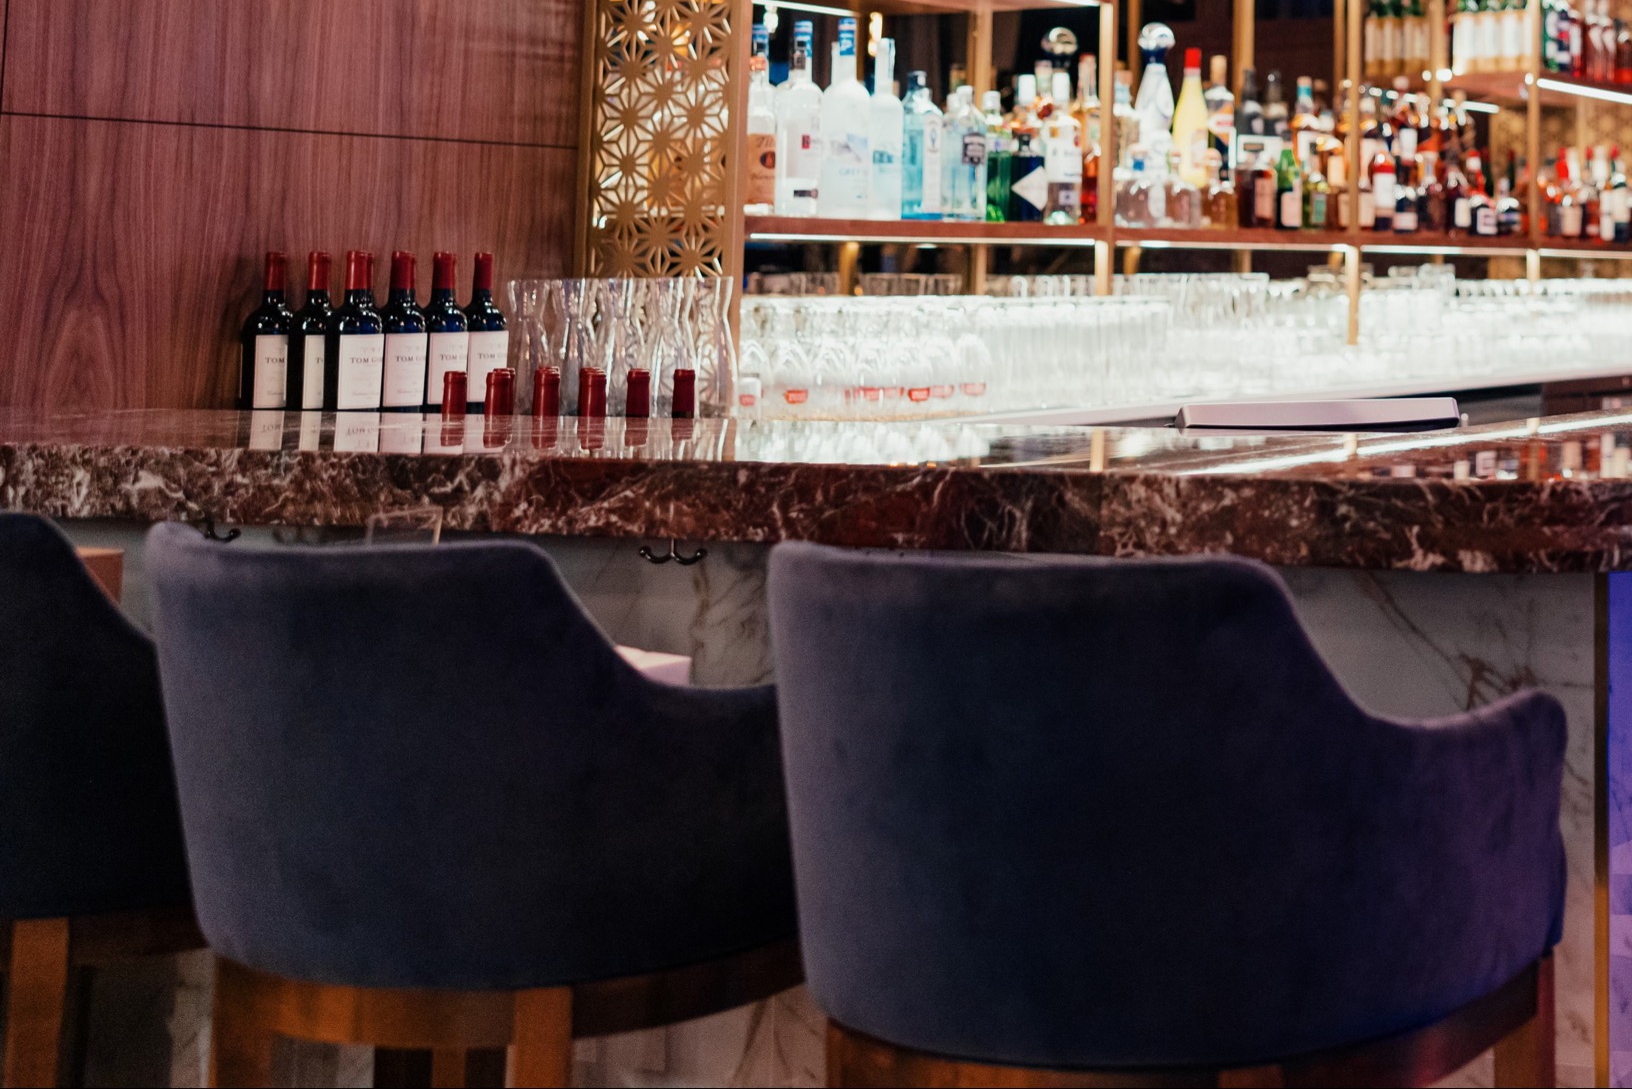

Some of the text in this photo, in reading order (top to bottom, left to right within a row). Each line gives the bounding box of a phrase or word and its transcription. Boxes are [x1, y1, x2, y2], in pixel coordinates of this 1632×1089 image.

[265, 356, 285, 364] TOM
[395, 355, 414, 363] TOM
[440, 353, 457, 361] TOM
[478, 352, 495, 360] TOM
